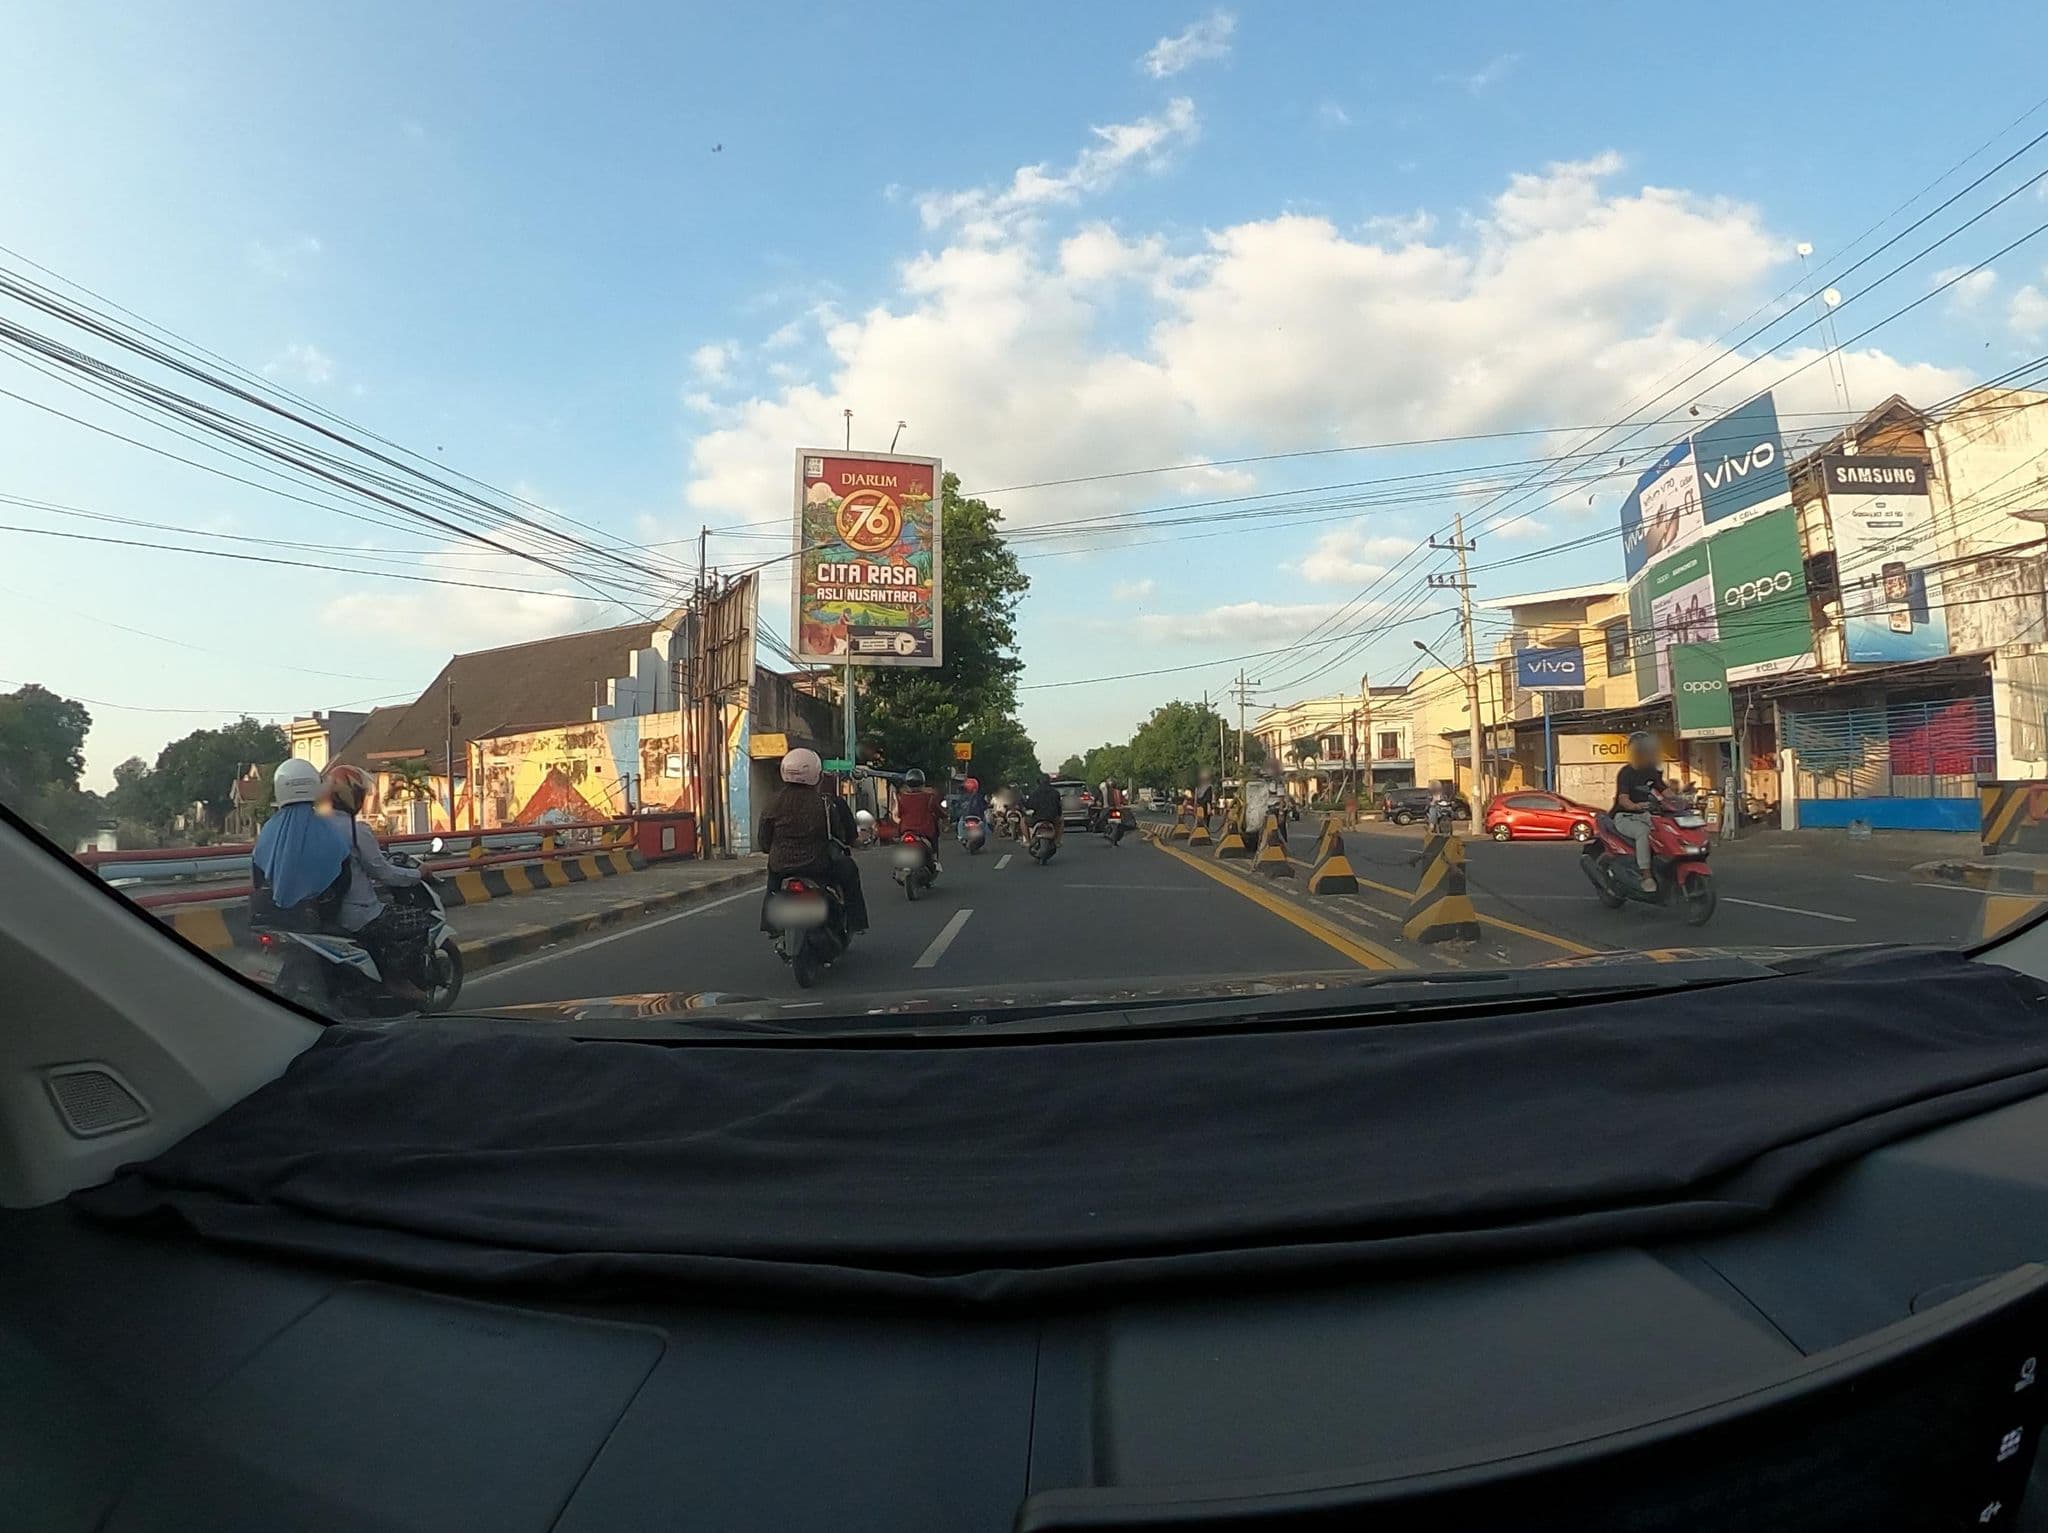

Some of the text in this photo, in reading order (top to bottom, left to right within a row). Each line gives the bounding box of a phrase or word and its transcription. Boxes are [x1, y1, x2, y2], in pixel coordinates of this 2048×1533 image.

[1703, 441, 1775, 490] vivo
[841, 473, 898, 488] DJARUM
[1836, 467, 1916, 484] SAMSUNG
[846, 496, 889, 542] 76
[817, 564, 917, 585] CITA RASA
[817, 587, 917, 603] ASLI NUSANTARA
[1725, 571, 1793, 609] oppo
[1527, 659, 1576, 674] vivo
[1683, 680, 1722, 694] oppo
